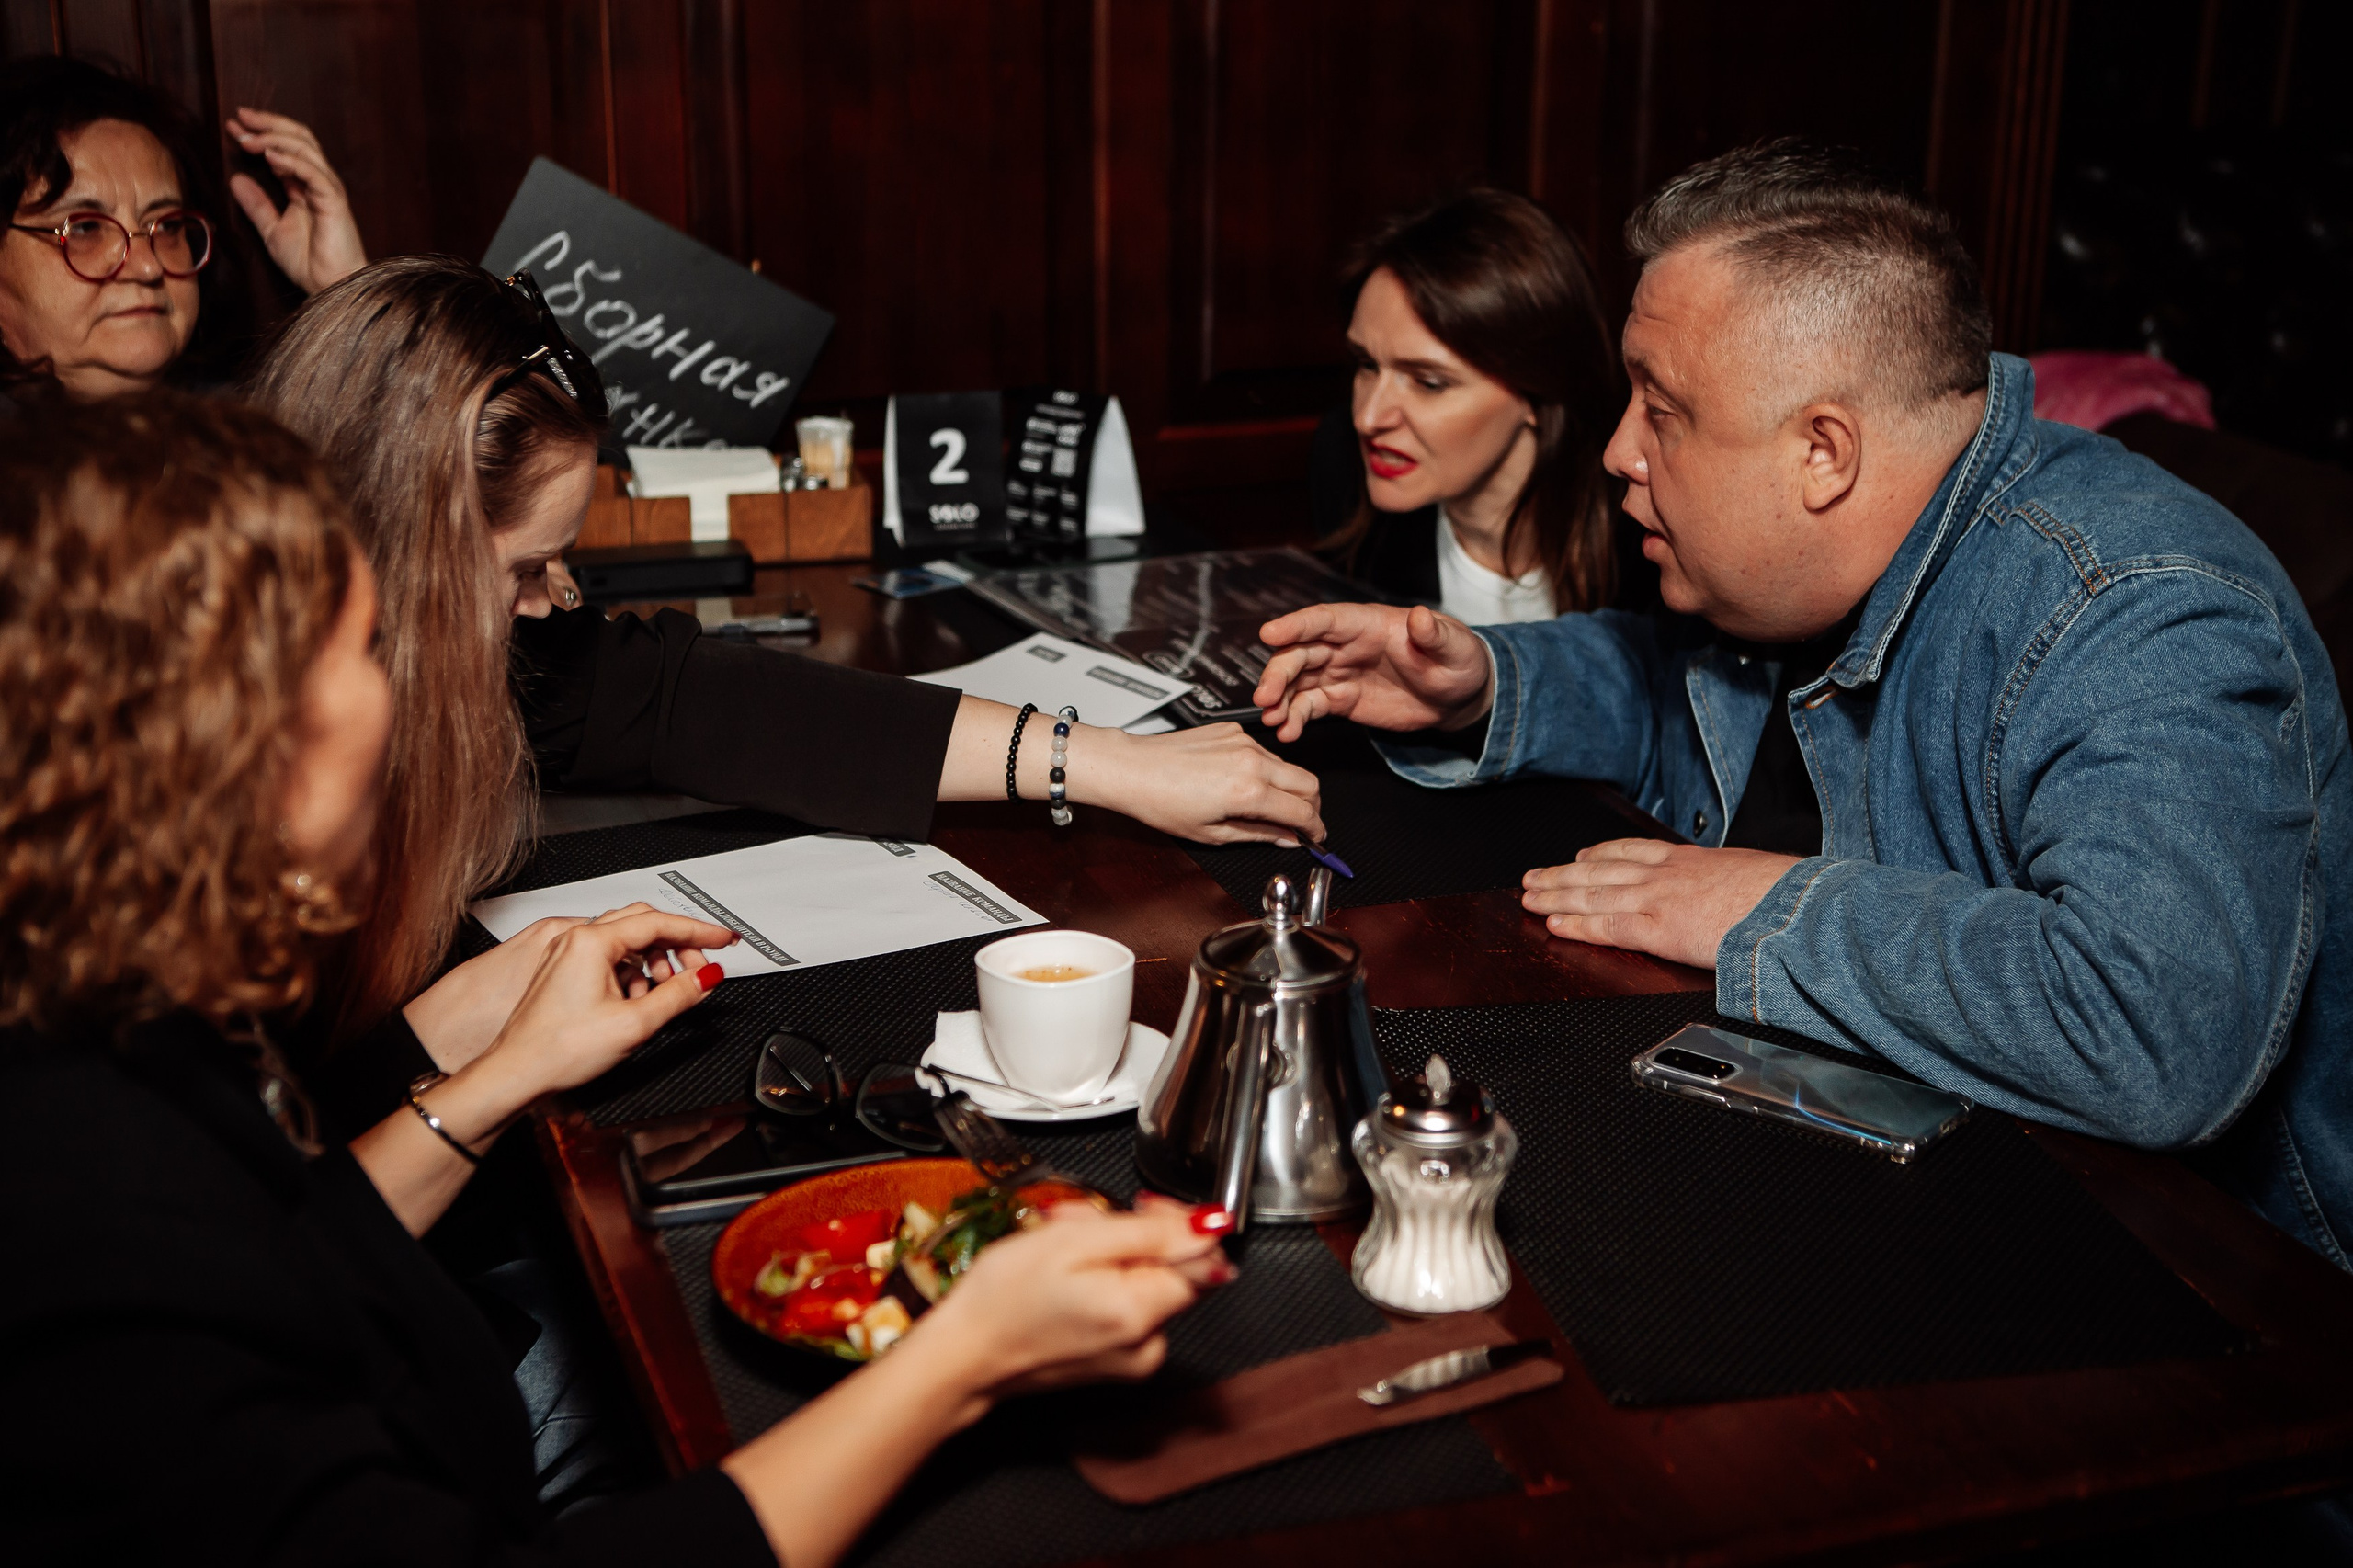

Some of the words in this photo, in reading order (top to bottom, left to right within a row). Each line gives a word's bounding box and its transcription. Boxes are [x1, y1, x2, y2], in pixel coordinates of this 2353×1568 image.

[928, 427, 970, 485] 2
[665, 872, 698, 895] НАЗВАНИЕ
[691, 892, 725, 915] КОМАНДЫ
[935, 873, 976, 897] НАЗВАНИЕ
[972, 896, 1014, 922] КОМАНДЫ
